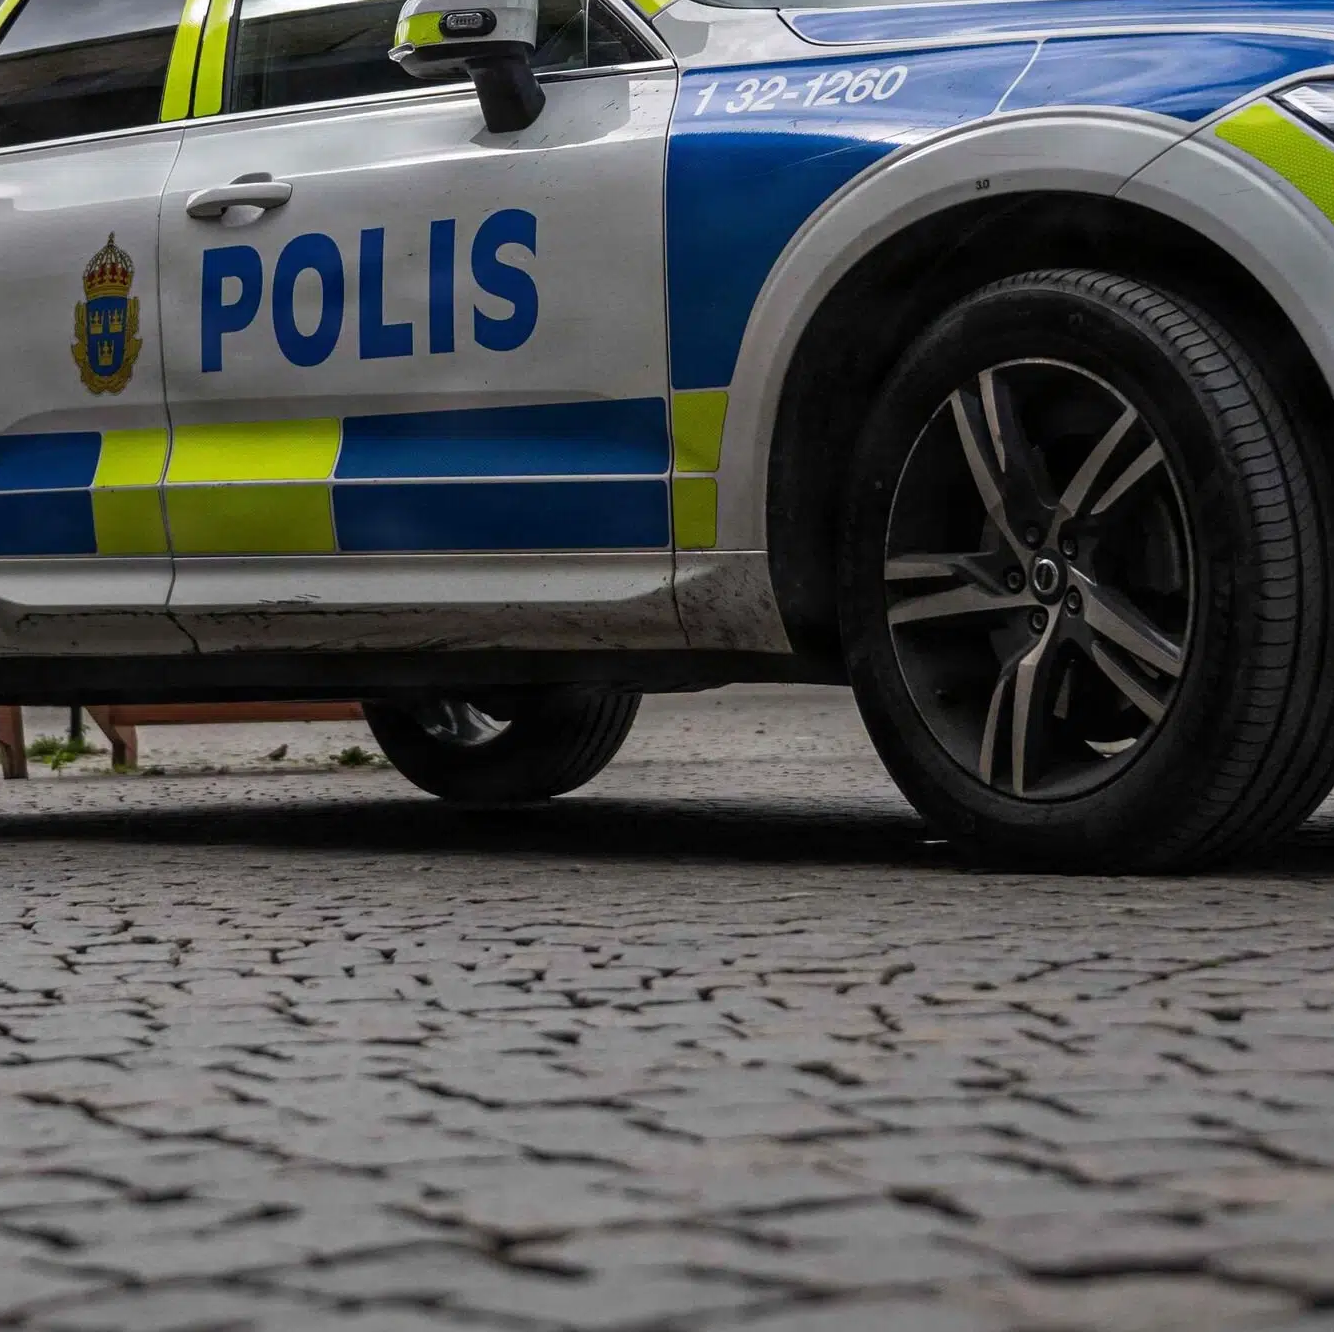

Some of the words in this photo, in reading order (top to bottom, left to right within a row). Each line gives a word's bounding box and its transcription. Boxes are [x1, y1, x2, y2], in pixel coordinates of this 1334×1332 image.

[694, 81, 718, 116] 1
[725, 65, 908, 114] 32-1260
[201, 208, 539, 373] POLIS
